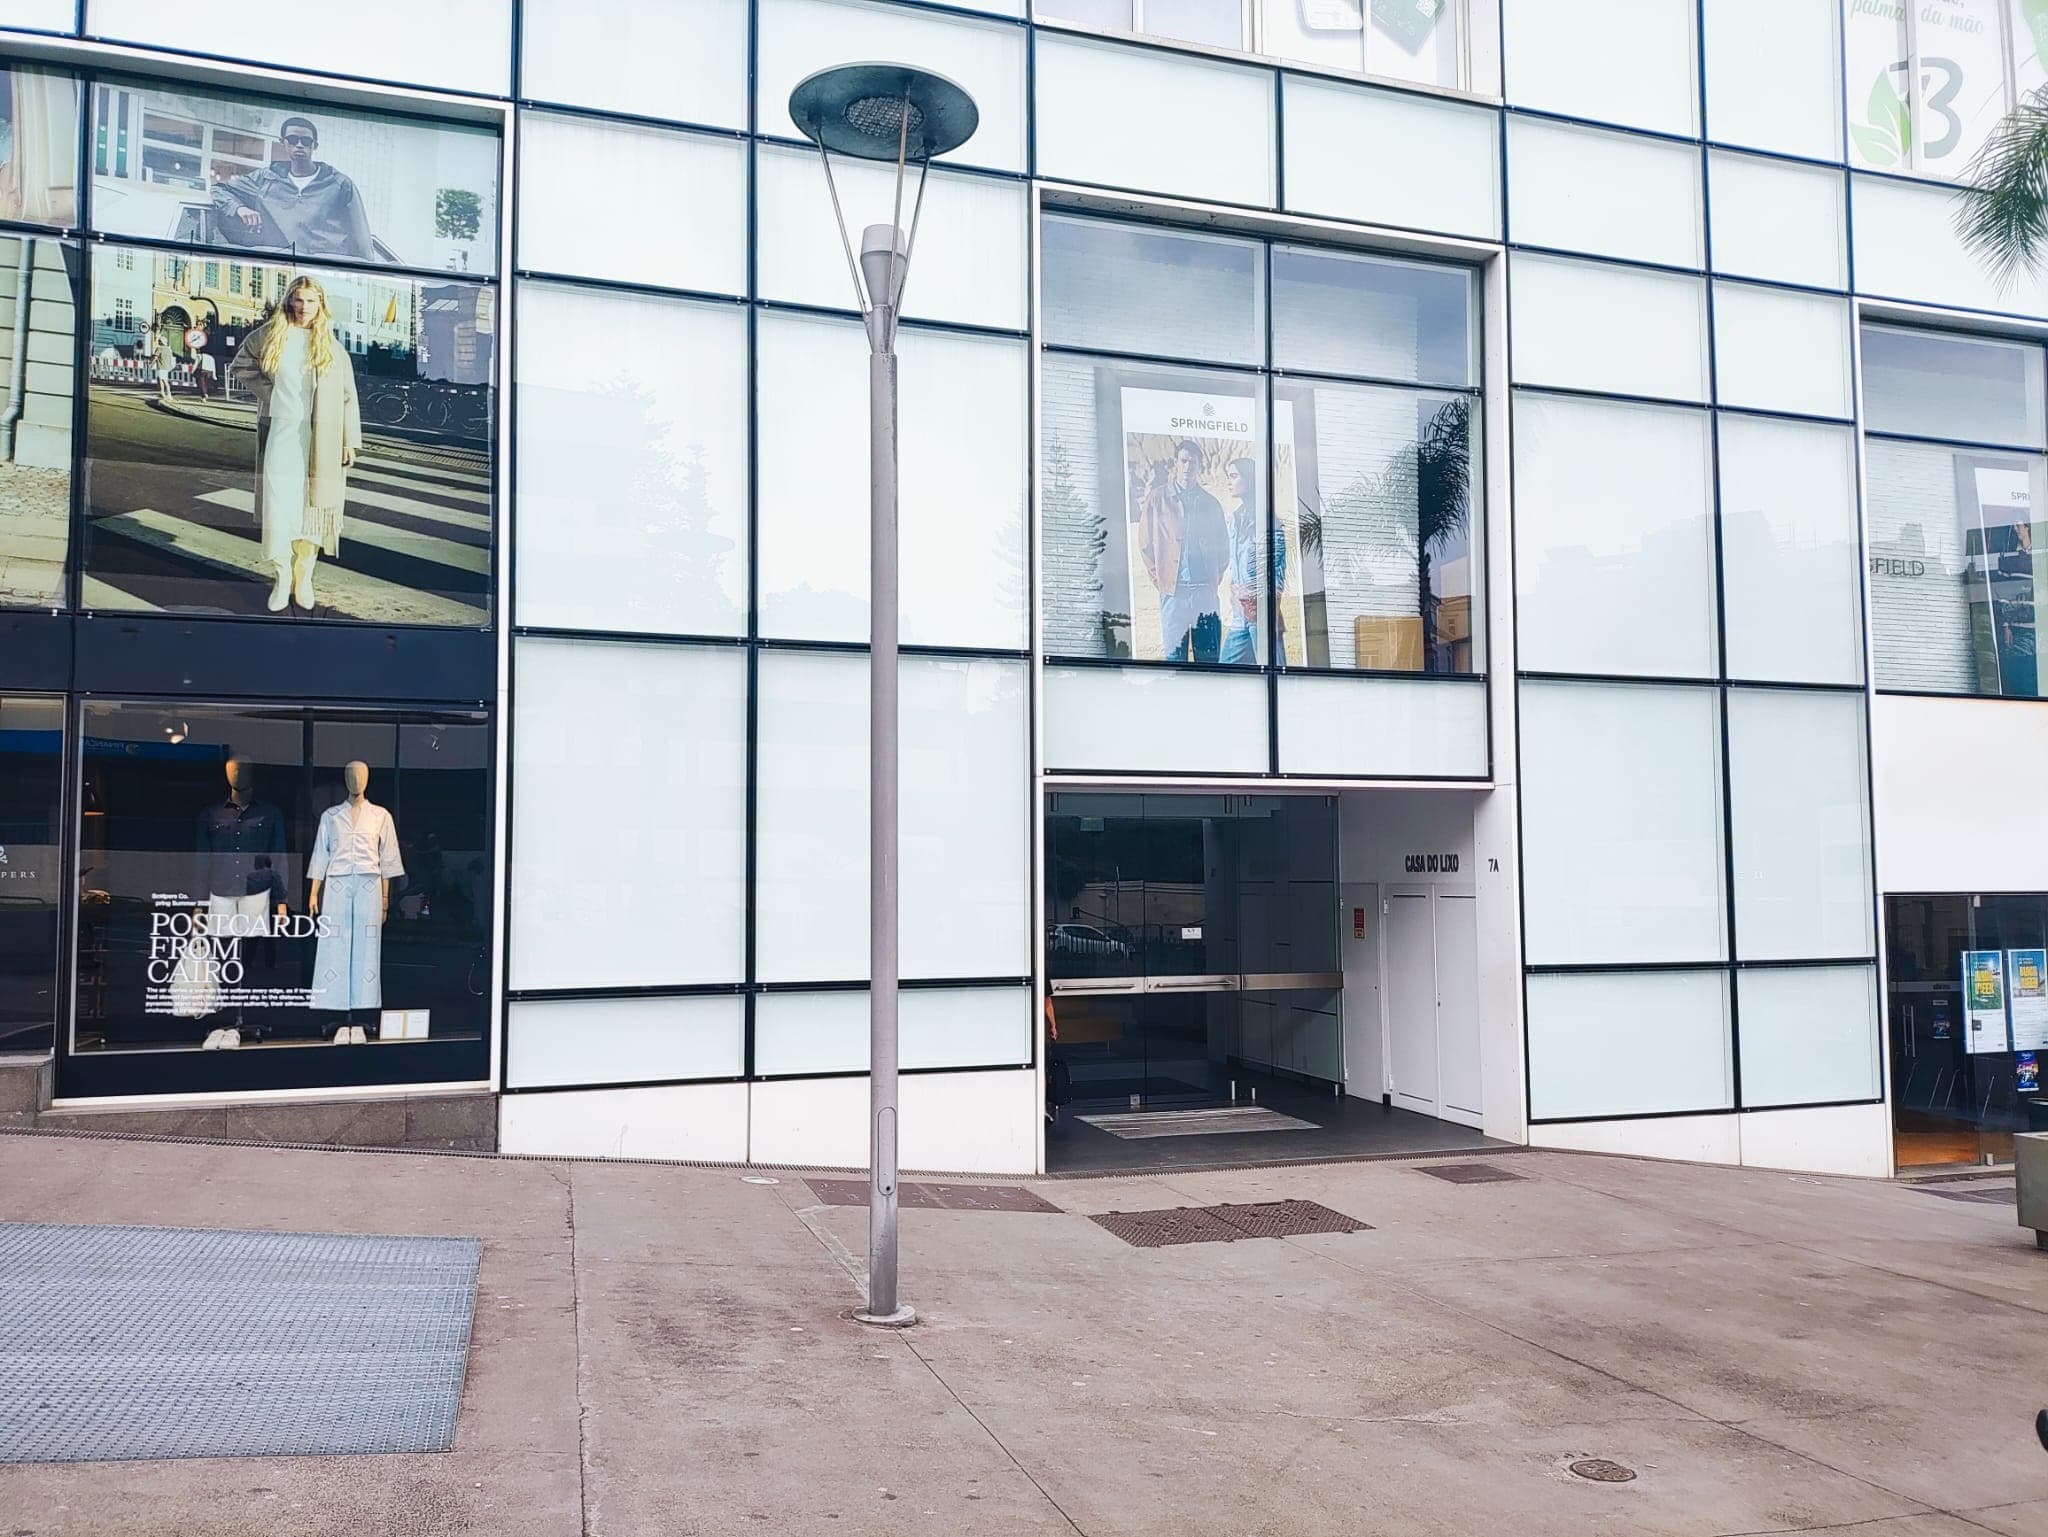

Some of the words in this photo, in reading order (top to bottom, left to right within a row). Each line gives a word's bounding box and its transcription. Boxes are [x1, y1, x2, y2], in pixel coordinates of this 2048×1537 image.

[1170, 417, 1249, 433] SPRINGFIELD
[1405, 854, 1426, 873] CASA
[1427, 854, 1439, 873] DO
[1440, 854, 1460, 873] LIXO
[1488, 858, 1499, 873] 7A
[150, 912, 332, 938] POSTCARDS
[148, 936, 242, 961] FROM
[147, 959, 244, 984] CAIRO
